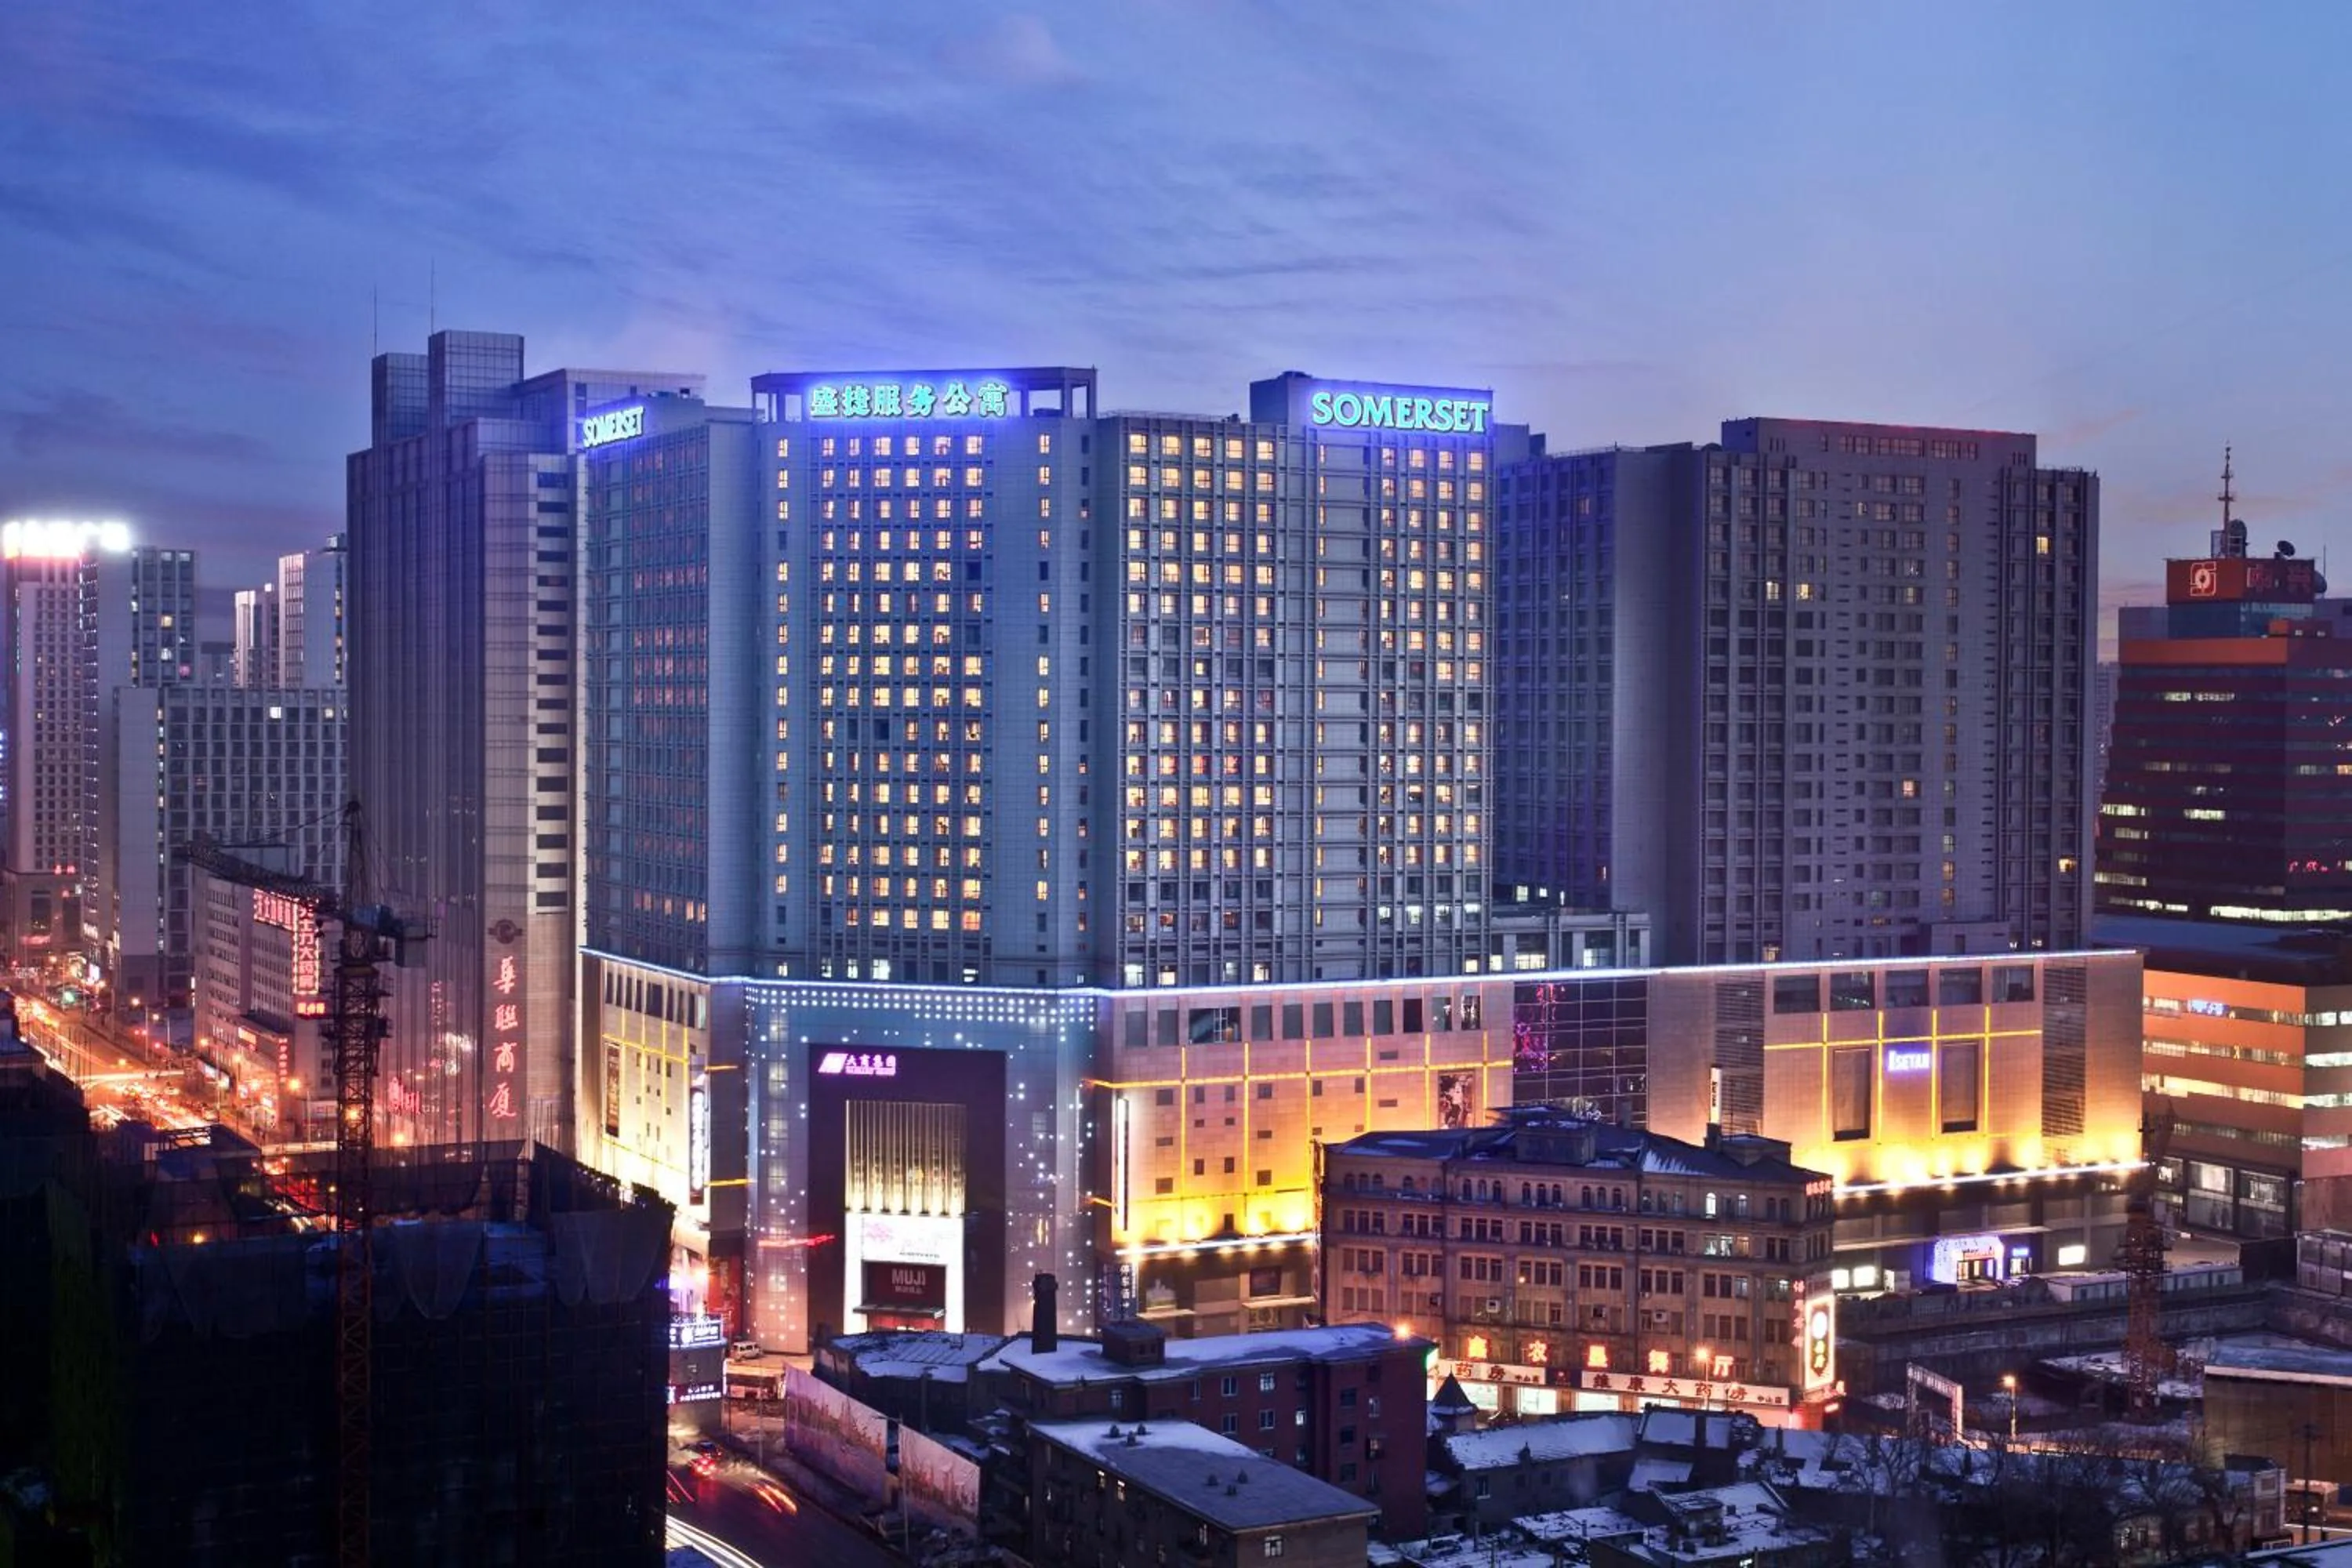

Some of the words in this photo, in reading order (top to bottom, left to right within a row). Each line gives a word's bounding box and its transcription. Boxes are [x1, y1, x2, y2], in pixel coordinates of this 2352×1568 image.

[811, 383, 1007, 416] 盛捷服务公寓
[1312, 392, 1489, 433] SOMERSET
[583, 405, 644, 448] SOMERSET
[891, 1268, 926, 1286] MUJI
